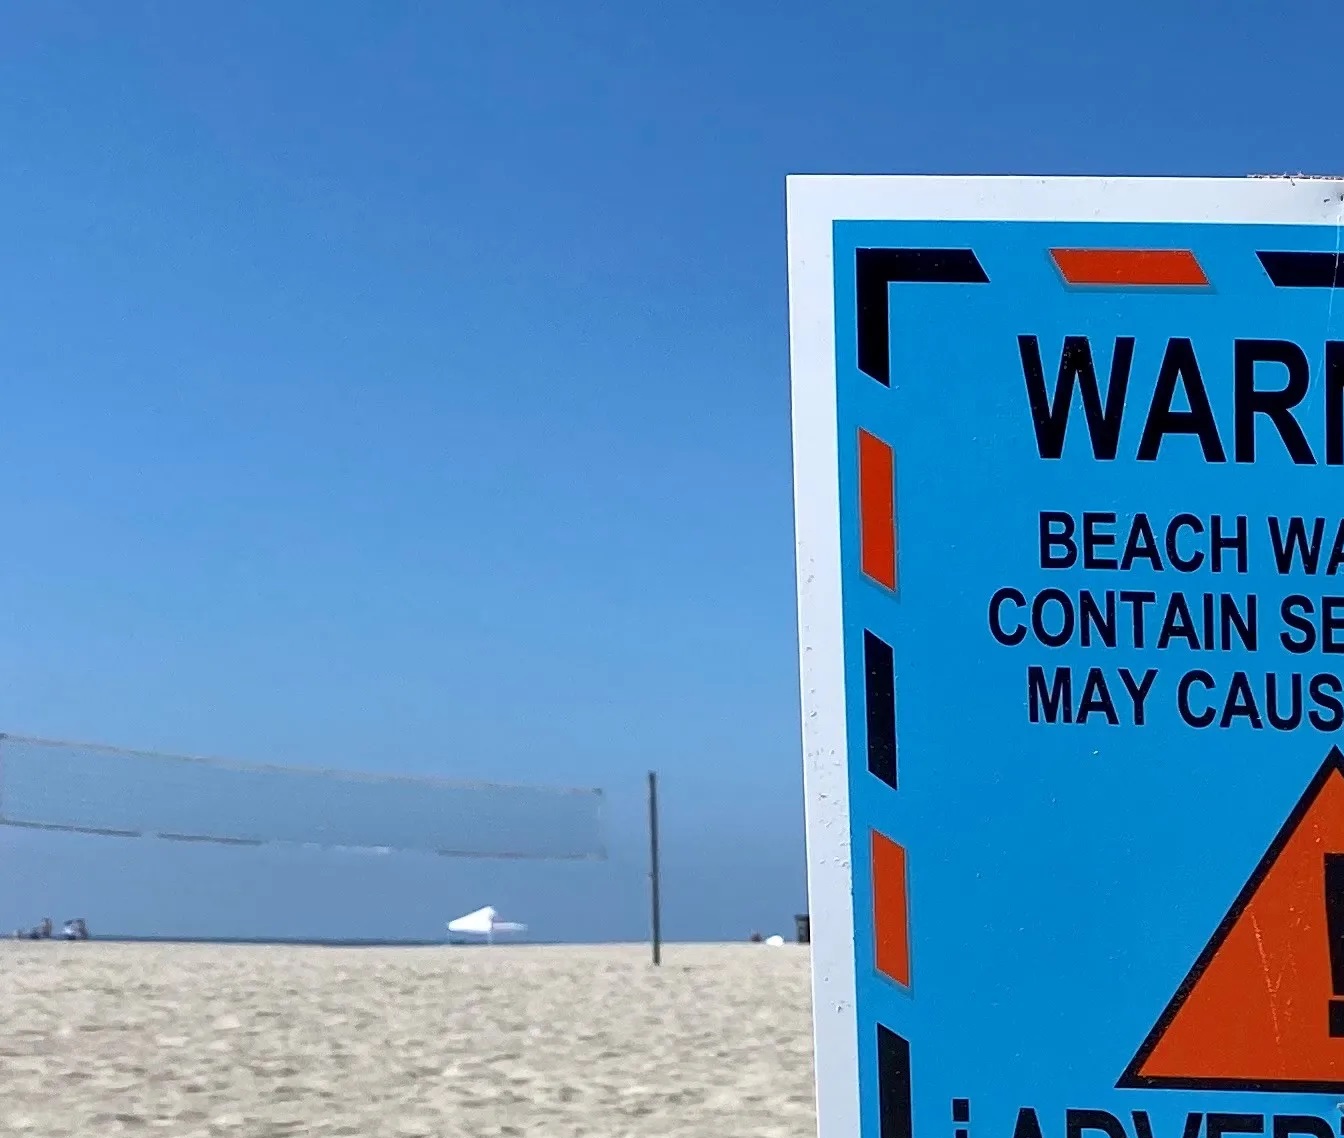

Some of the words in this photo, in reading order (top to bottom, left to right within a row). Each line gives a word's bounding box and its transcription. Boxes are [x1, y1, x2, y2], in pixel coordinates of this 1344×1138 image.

[1039, 511, 1248, 573] BEACH
[988, 587, 1257, 652] CONTAIN
[1028, 666, 1158, 726] MAY
